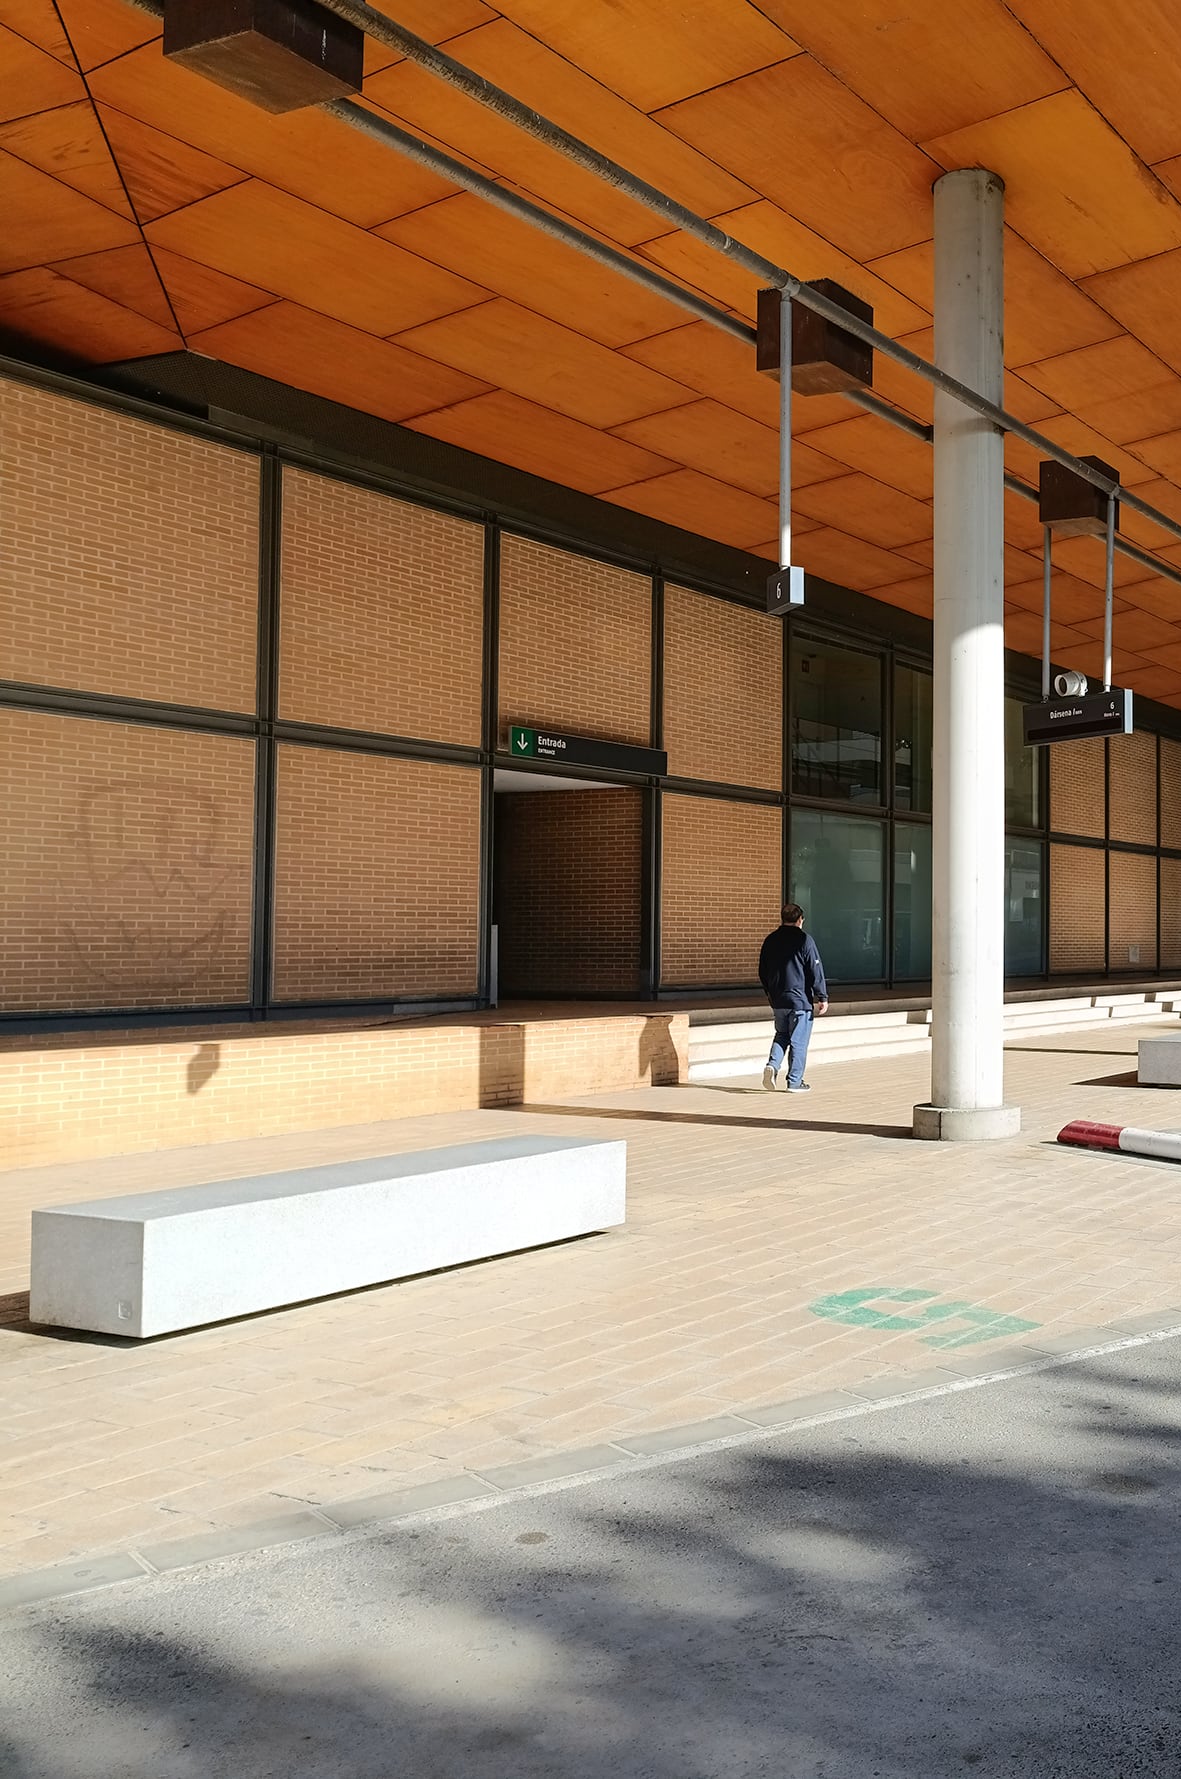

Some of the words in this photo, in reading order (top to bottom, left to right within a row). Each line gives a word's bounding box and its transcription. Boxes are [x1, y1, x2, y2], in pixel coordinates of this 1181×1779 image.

[776, 582, 782, 599] 6
[1110, 701, 1115, 710] 6
[1049, 709, 1072, 719] Dársena
[537, 735, 566, 749] Entrada
